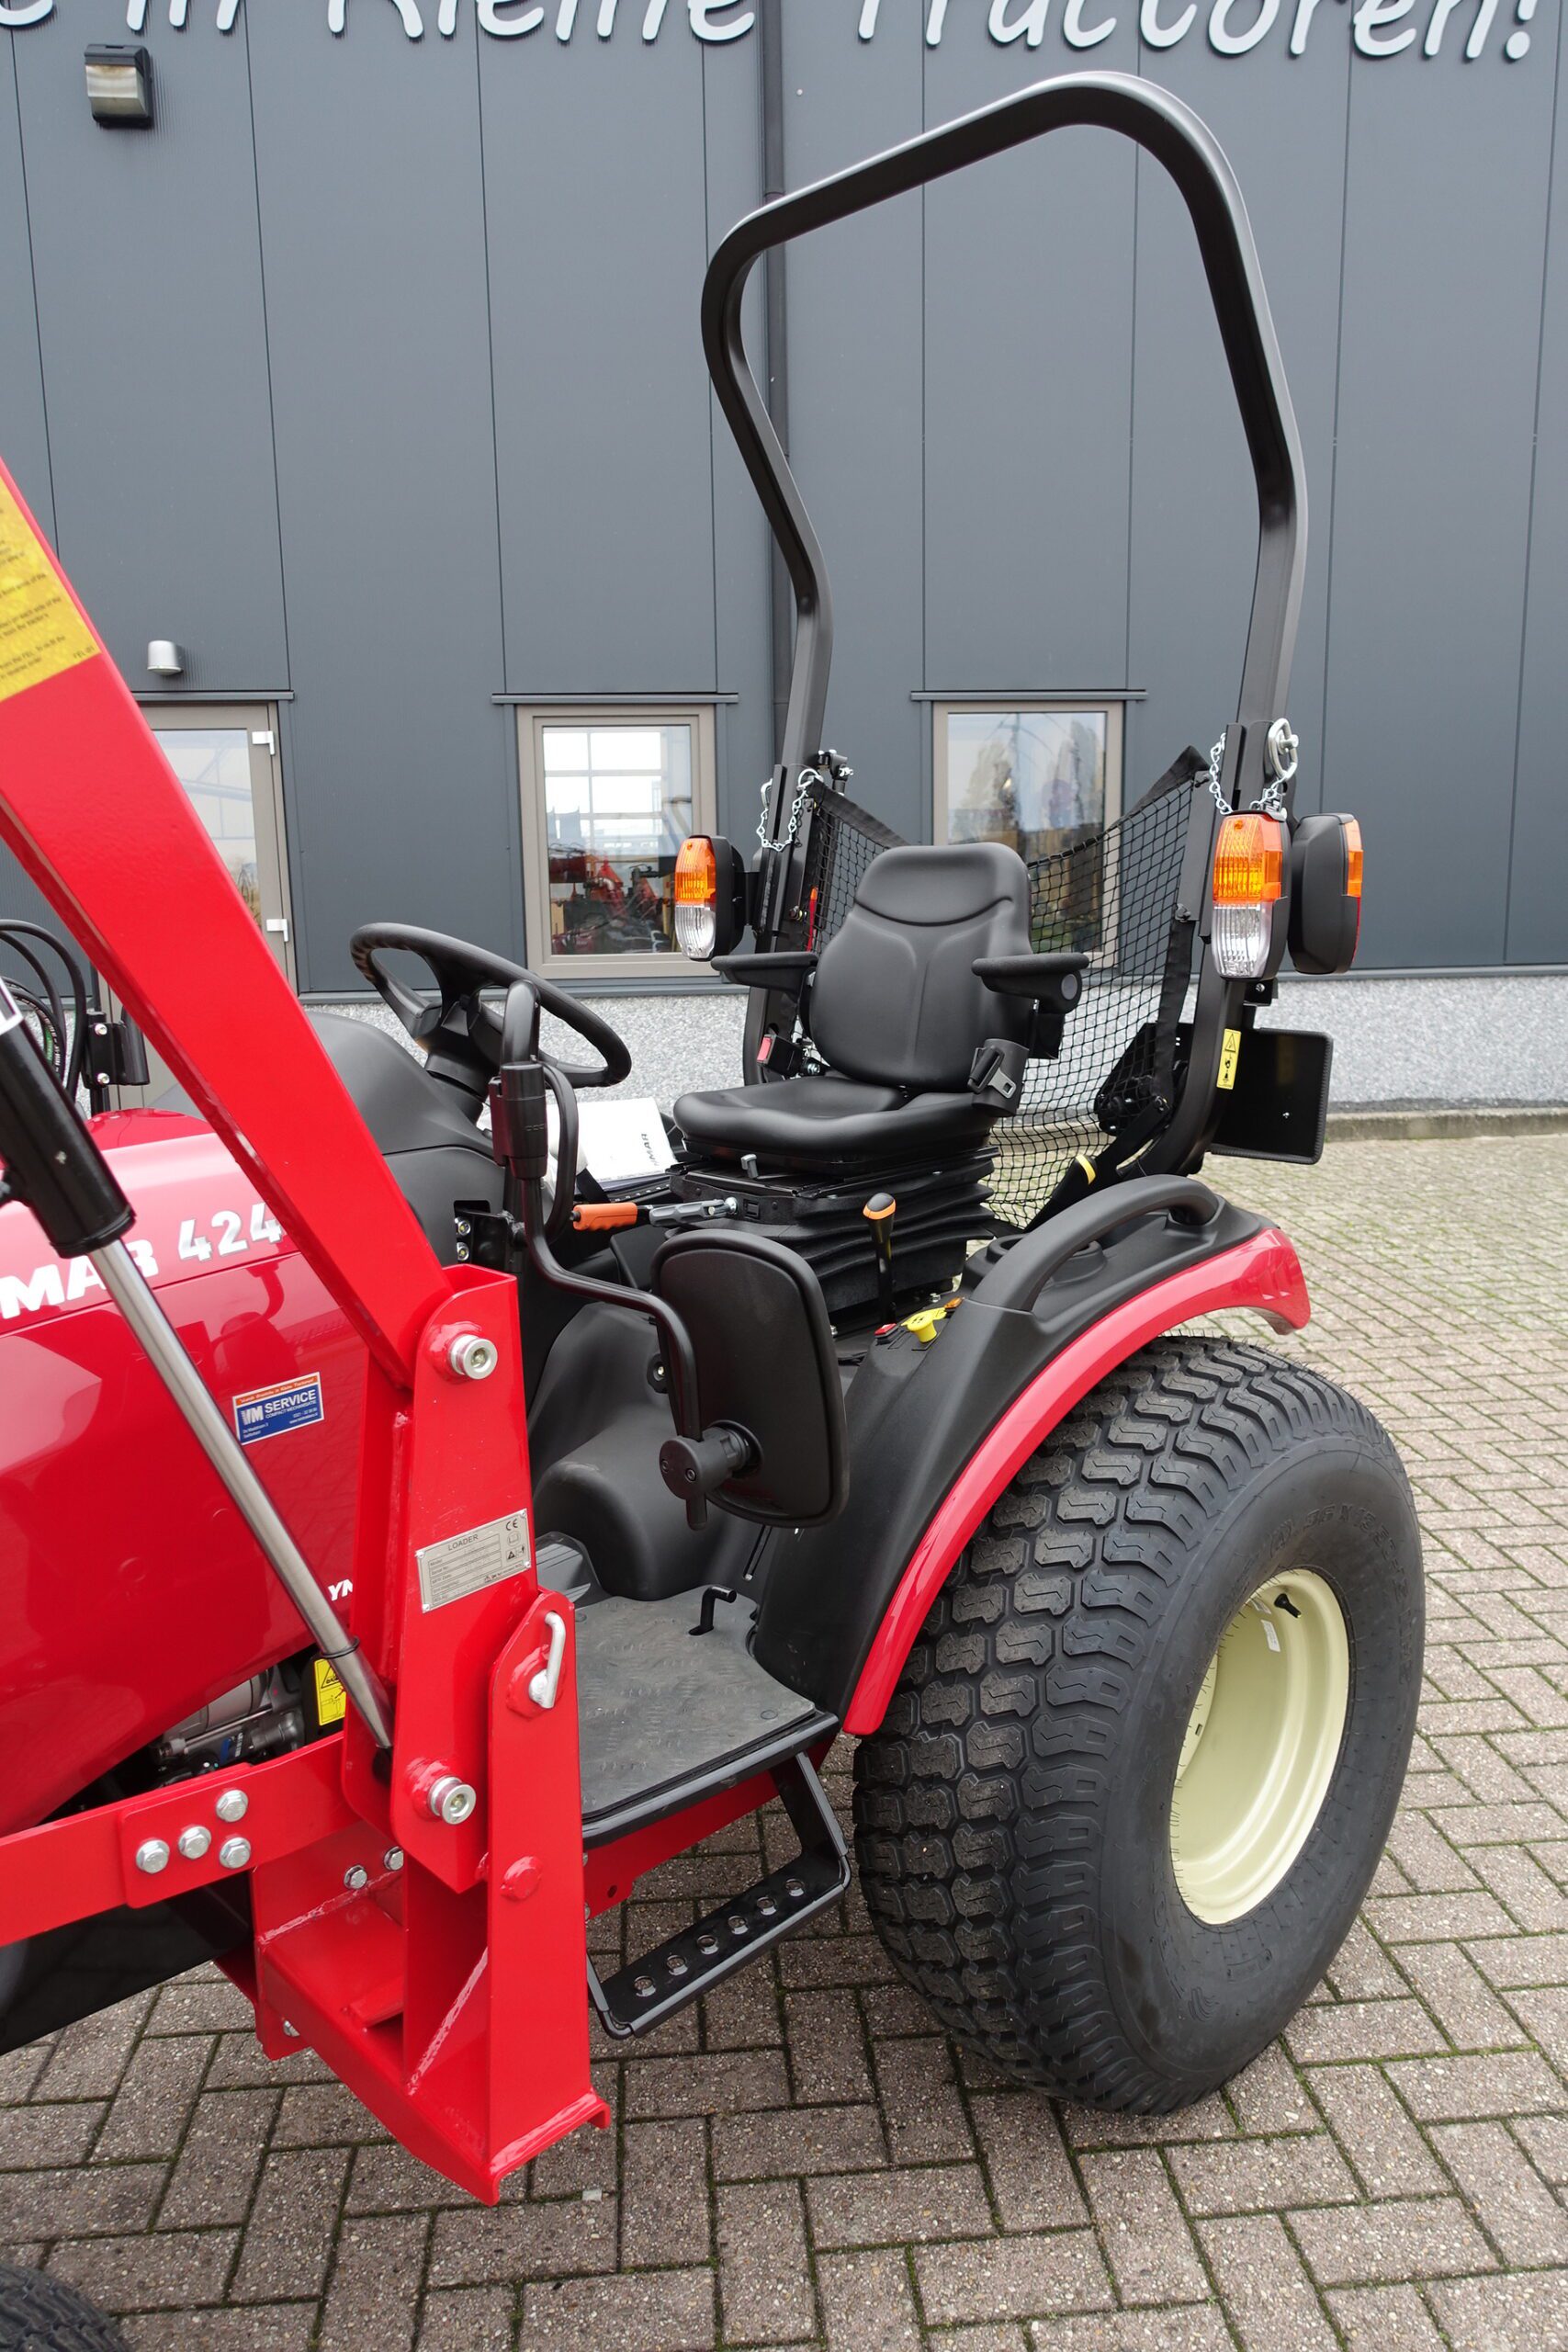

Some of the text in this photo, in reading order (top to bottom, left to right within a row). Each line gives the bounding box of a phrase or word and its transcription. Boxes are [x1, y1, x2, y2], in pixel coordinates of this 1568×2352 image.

[177, 1202, 284, 1261] 424
[264, 1388, 317, 1414] SERVICE
[447, 1533, 479, 1552] LOADER
